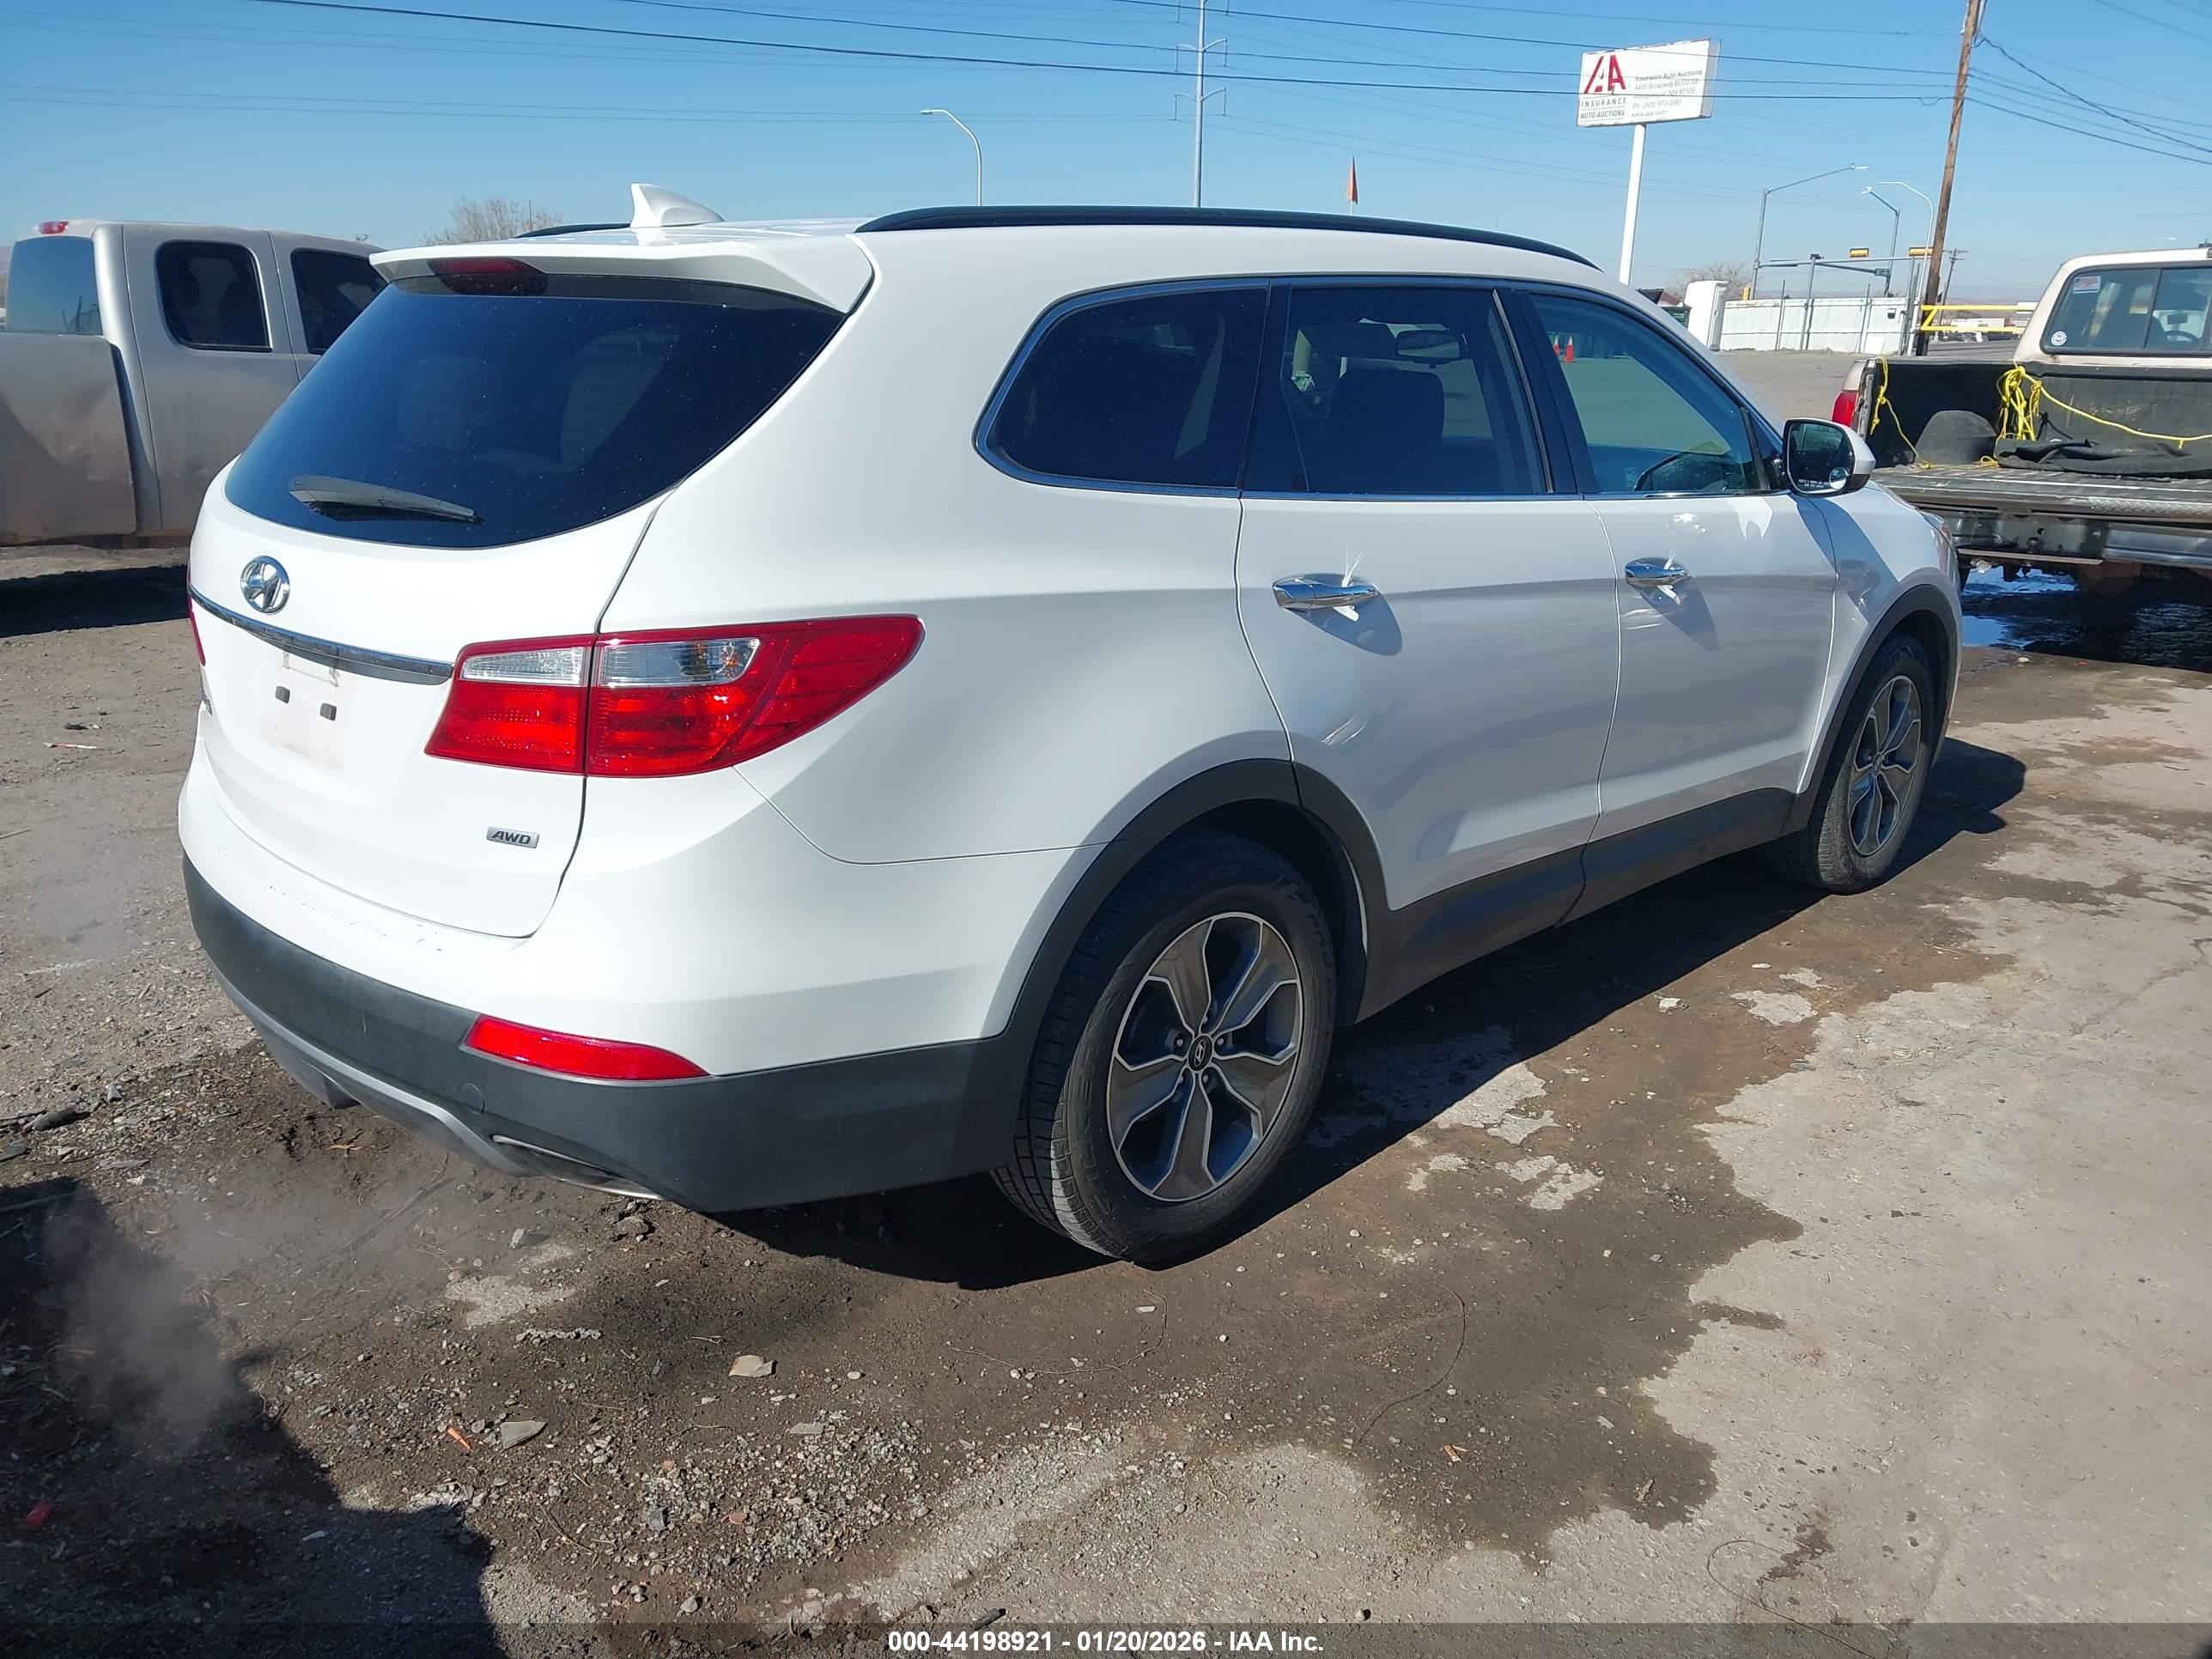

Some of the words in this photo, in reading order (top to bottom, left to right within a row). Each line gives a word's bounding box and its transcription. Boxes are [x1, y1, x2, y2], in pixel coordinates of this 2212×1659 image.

[1581, 96, 1627, 108] INSURANCE
[1580, 111, 1595, 120] AUTO
[1595, 108, 1626, 118] AUCTIONS
[491, 830, 532, 845] AWD
